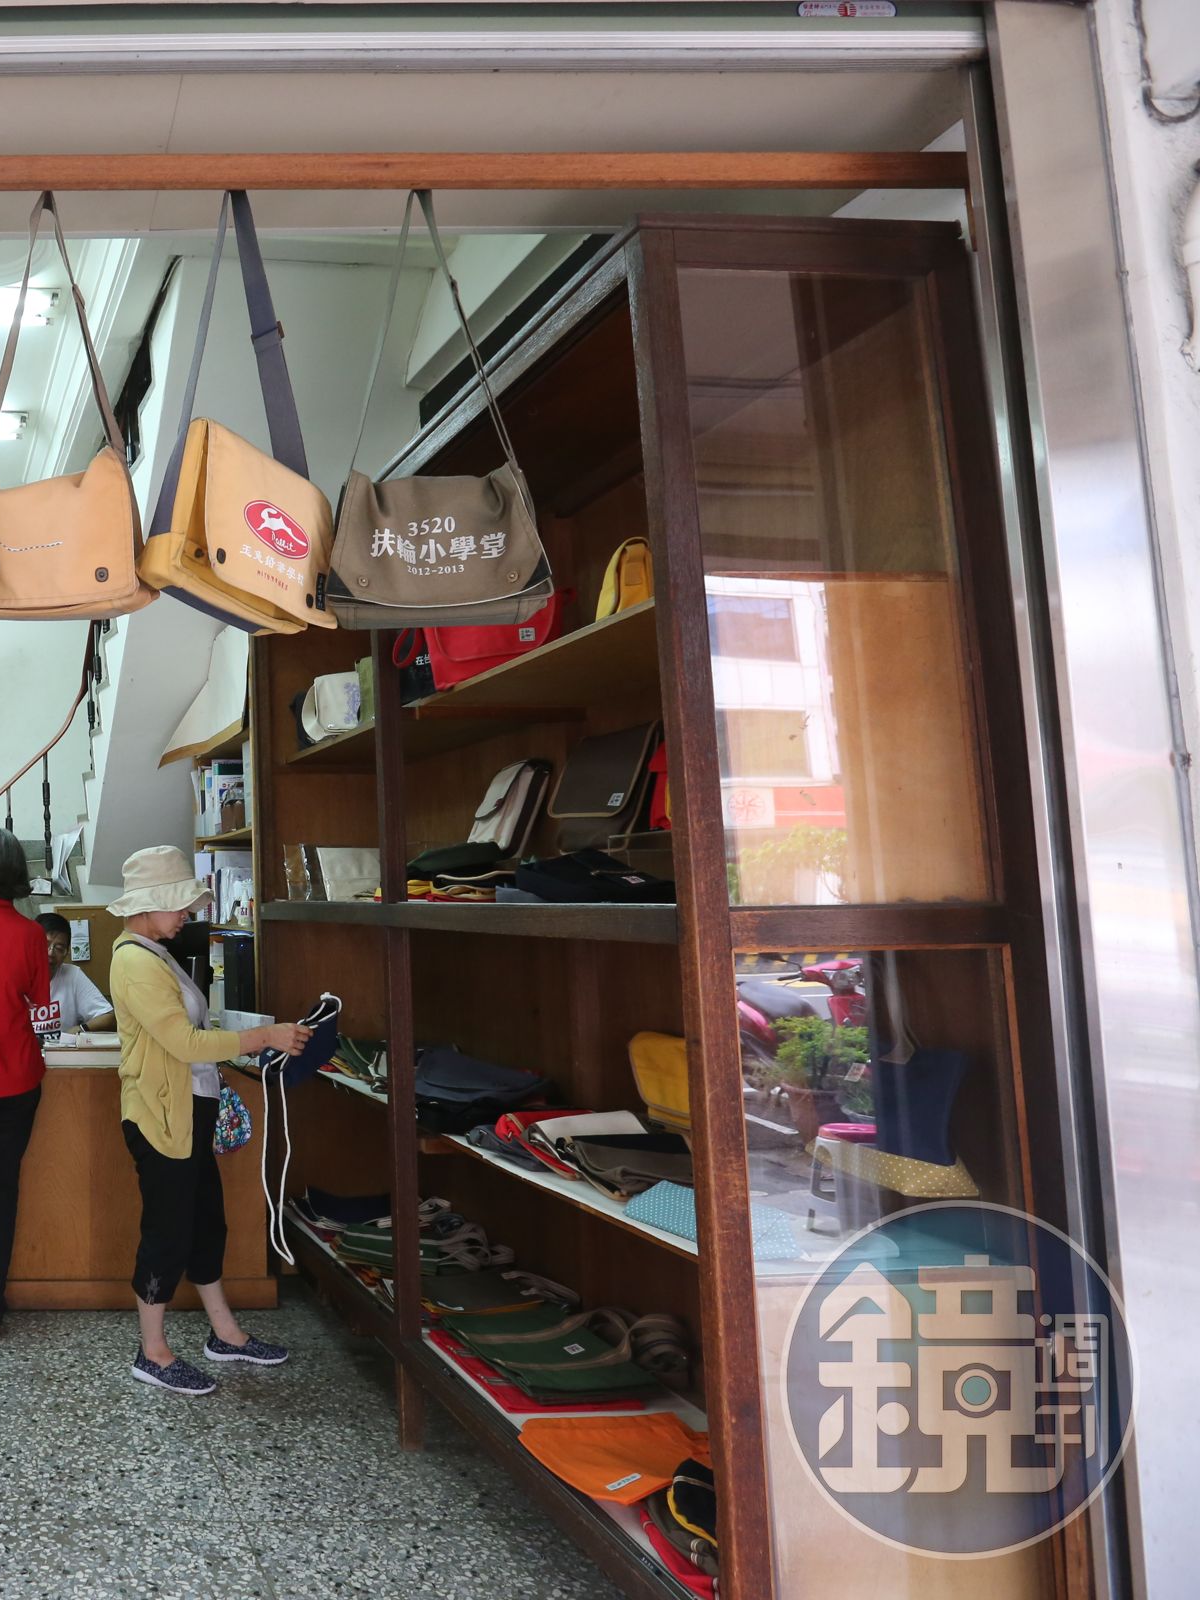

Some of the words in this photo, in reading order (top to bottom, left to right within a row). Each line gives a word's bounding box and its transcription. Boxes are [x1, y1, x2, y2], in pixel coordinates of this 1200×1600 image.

[407, 516, 456, 537] 3520
[370, 528, 507, 565] 扶輪小學堂
[407, 564, 465, 576] 2012-2013
